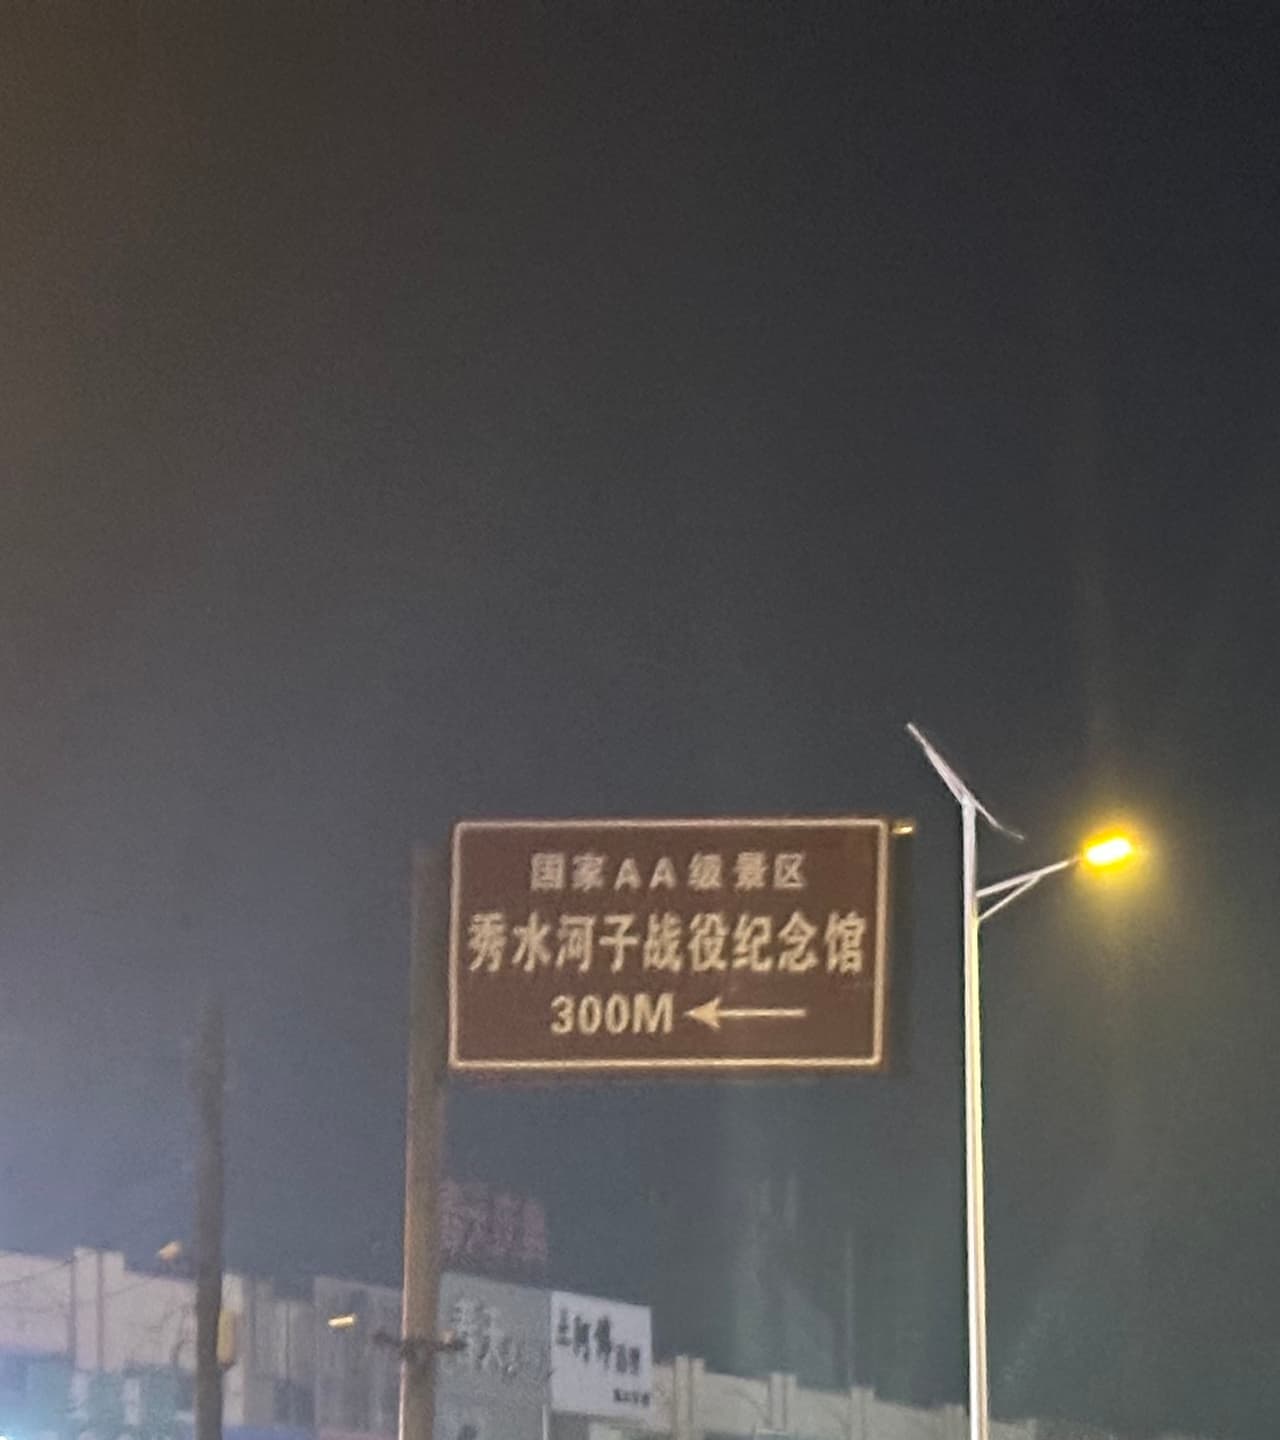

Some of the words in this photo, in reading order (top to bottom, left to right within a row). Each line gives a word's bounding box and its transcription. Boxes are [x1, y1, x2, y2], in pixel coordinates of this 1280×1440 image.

[530, 851, 808, 891] 国家AA级景区
[468, 911, 868, 973] 秀水河子战役纪念馆
[550, 993, 675, 1035] 300M
